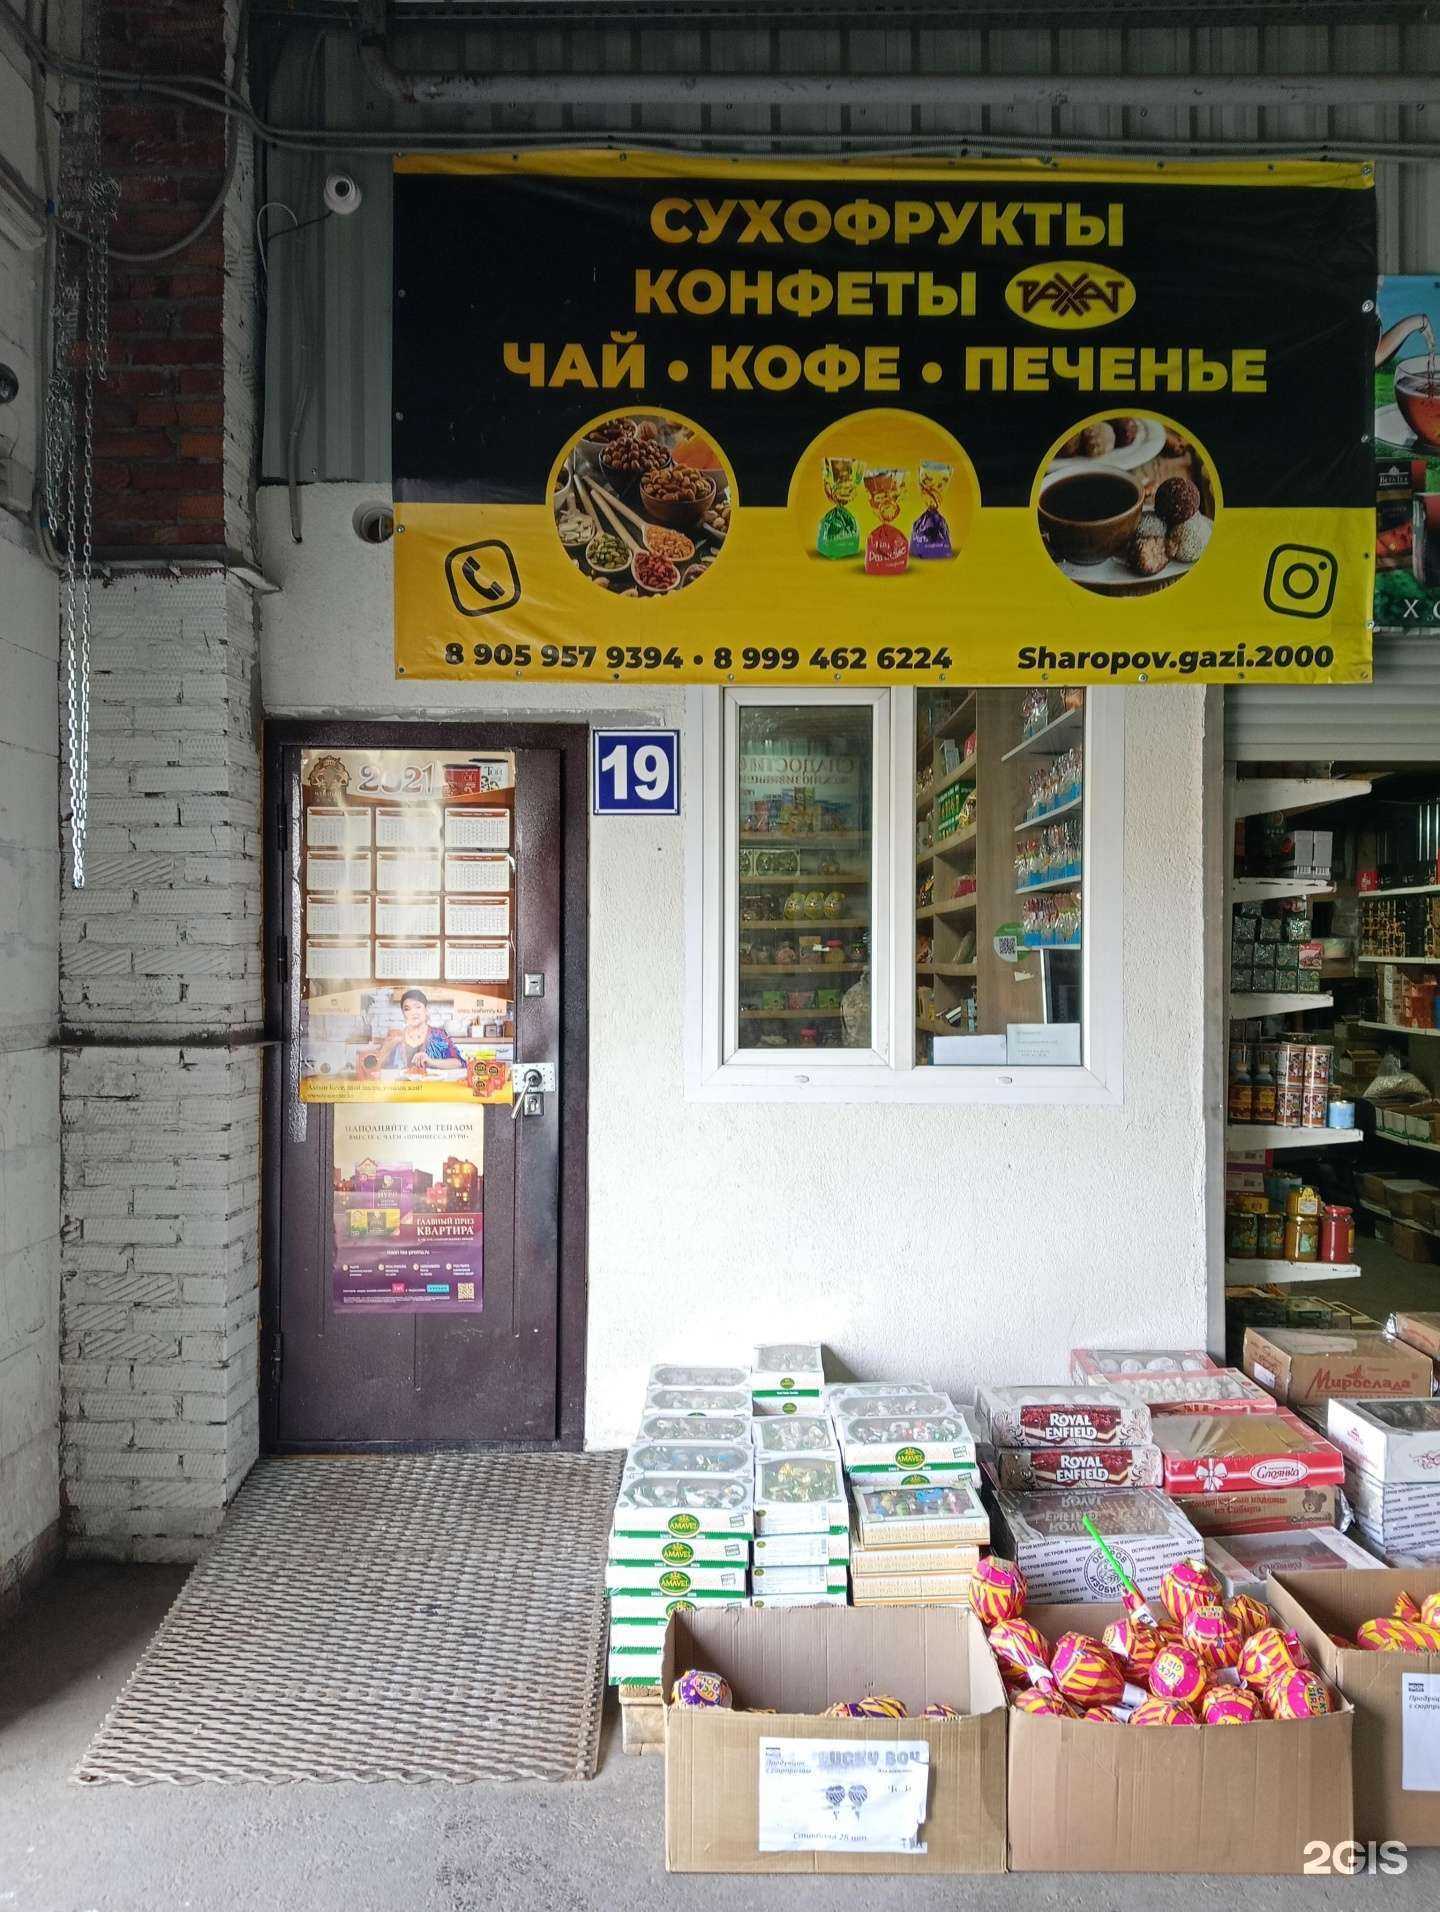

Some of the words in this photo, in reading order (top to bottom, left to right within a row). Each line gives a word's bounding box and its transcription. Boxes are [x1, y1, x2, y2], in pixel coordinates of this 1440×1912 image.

[650, 197, 1124, 247] СУХОФРУКТЫ
[635, 268, 976, 318] КОНФЕТЫ
[503, 330, 645, 388] ЧАЙ
[711, 344, 900, 392] КОФЕ
[965, 346, 1267, 392] ПЕЧЕНЬЕ
[444, 642, 464, 665] 8
[473, 644, 532, 666] 905
[541, 645, 597, 667] 957
[606, 646, 683, 669] 9394
[713, 647, 732, 670] 8
[742, 647, 799, 670] 999
[809, 647, 866, 670] 462
[877, 647, 952, 670] 6224
[1017, 642, 1334, 674] Sharopov.gazi.2000
[357, 761, 435, 794] 2021
[602, 745, 669, 800] 19
[413, 1124, 432, 1132] ДОМ
[436, 1124, 473, 1132] ТЕПЛОМ
[417, 1217, 453, 1225] ГЛАВНЫЙ
[455, 1217, 474, 1225] ПРИЗ
[417, 1226, 474, 1236] КВАРТИРА
[1306, 1368, 1411, 1399] Мирослада
[1046, 1426, 1097, 1439] ENFIELD
[1050, 1413, 1092, 1426] ROYAL
[1056, 1468, 1109, 1481] ENFIELD
[1061, 1455, 1103, 1468] ROYAL
